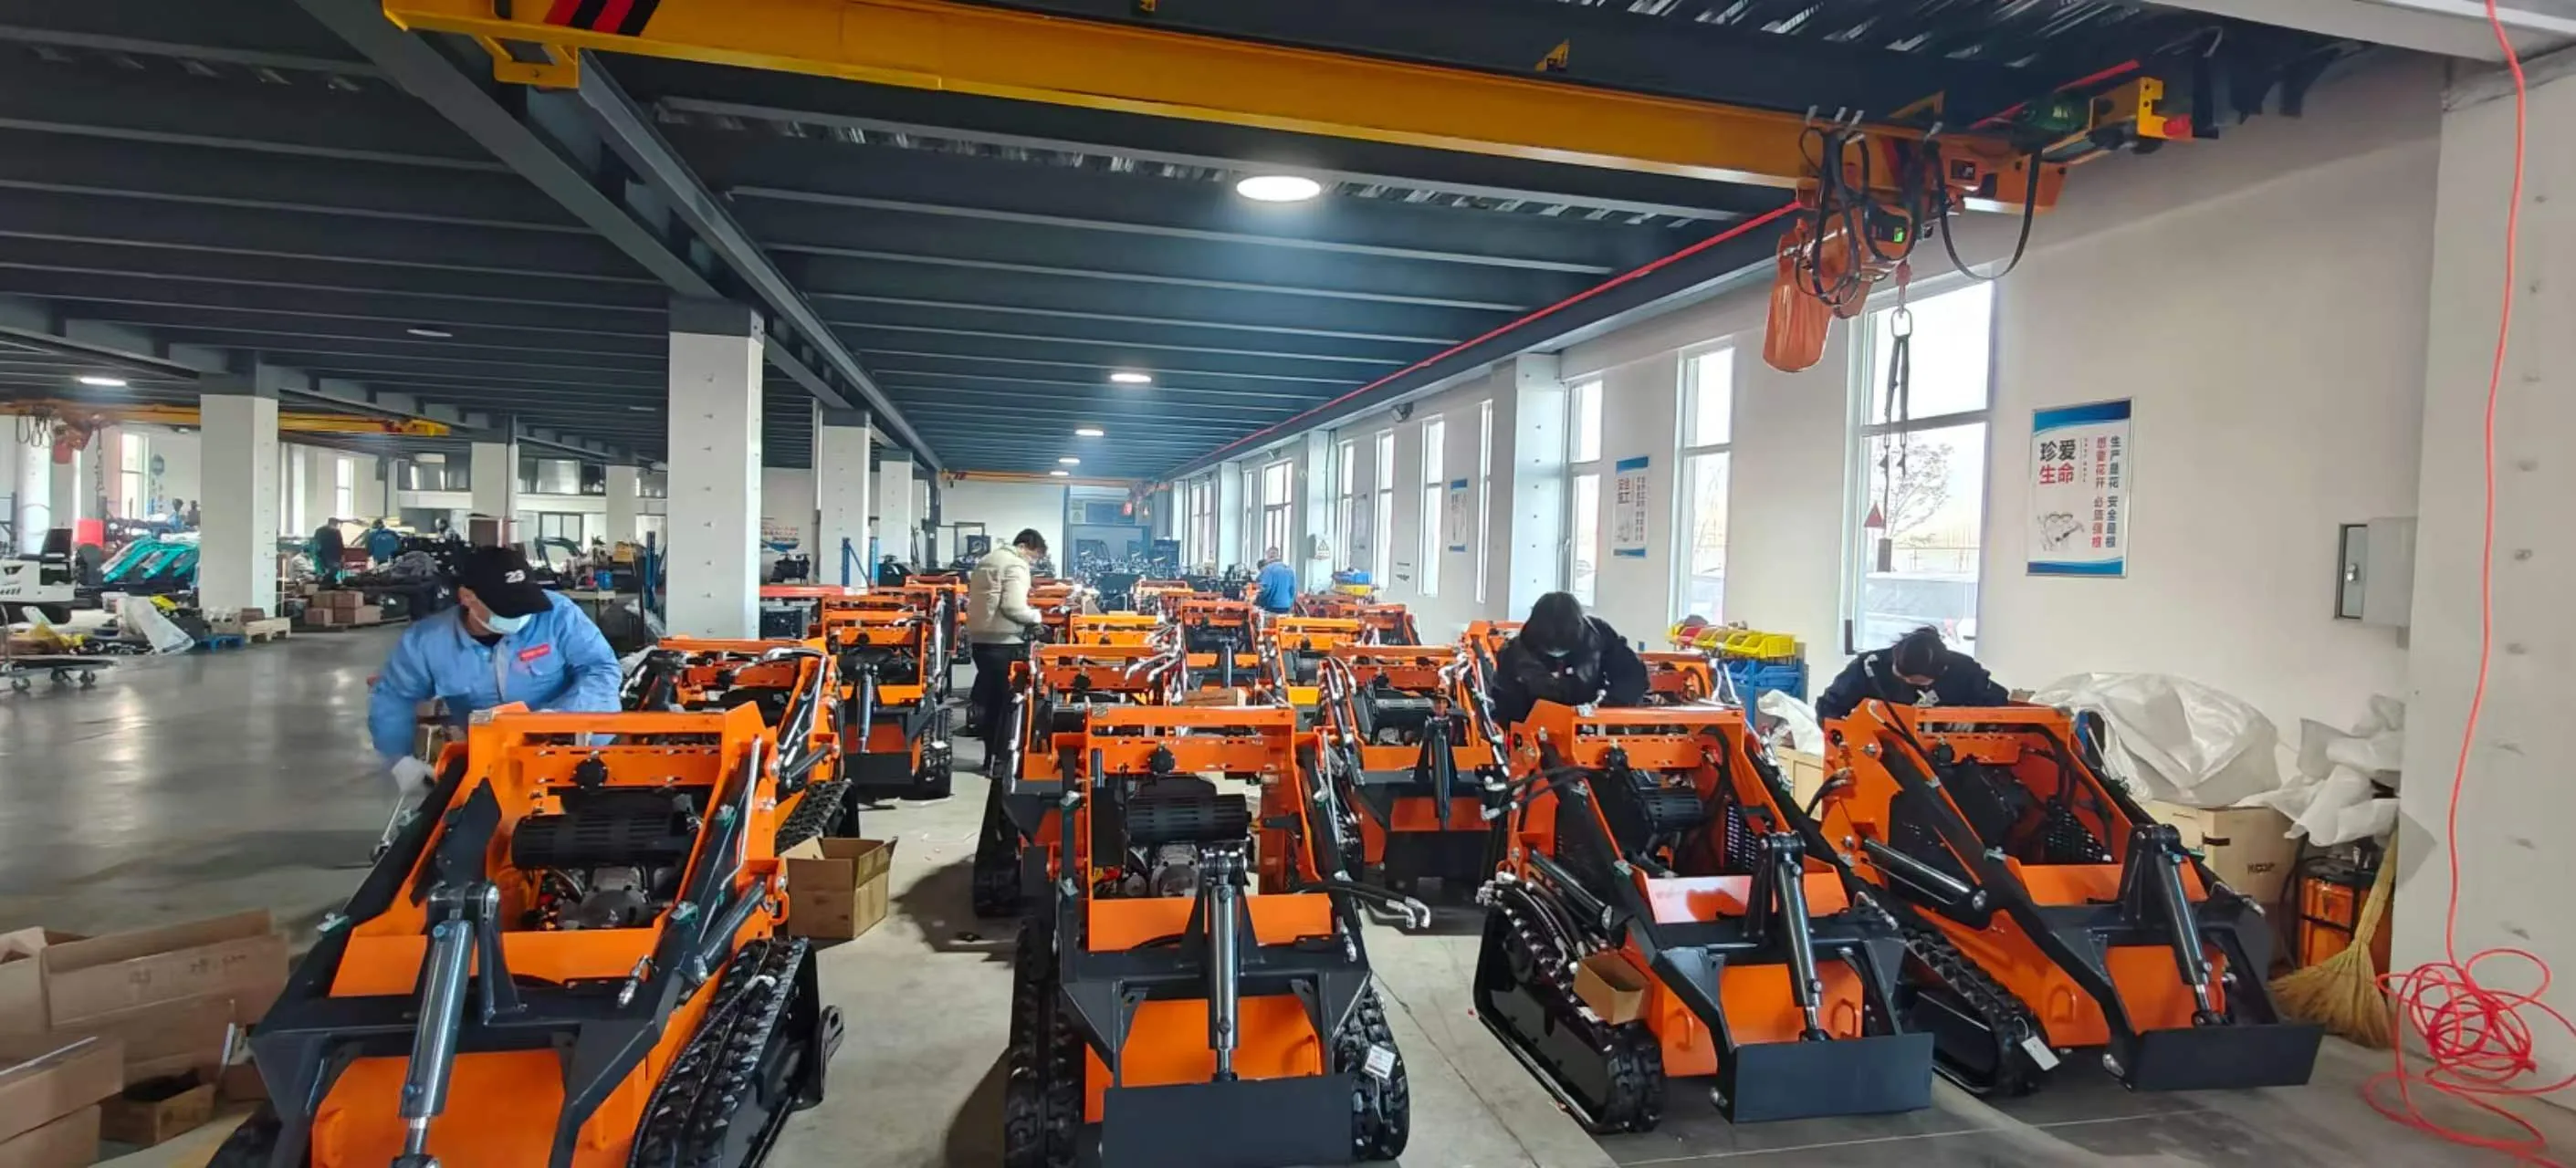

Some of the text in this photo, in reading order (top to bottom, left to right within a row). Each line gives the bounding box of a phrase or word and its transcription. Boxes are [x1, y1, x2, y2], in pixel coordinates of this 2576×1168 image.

[2040, 439, 2076, 461] 珍爱
[2039, 462, 2075, 484] 生命
[505, 568, 526, 584] 23
